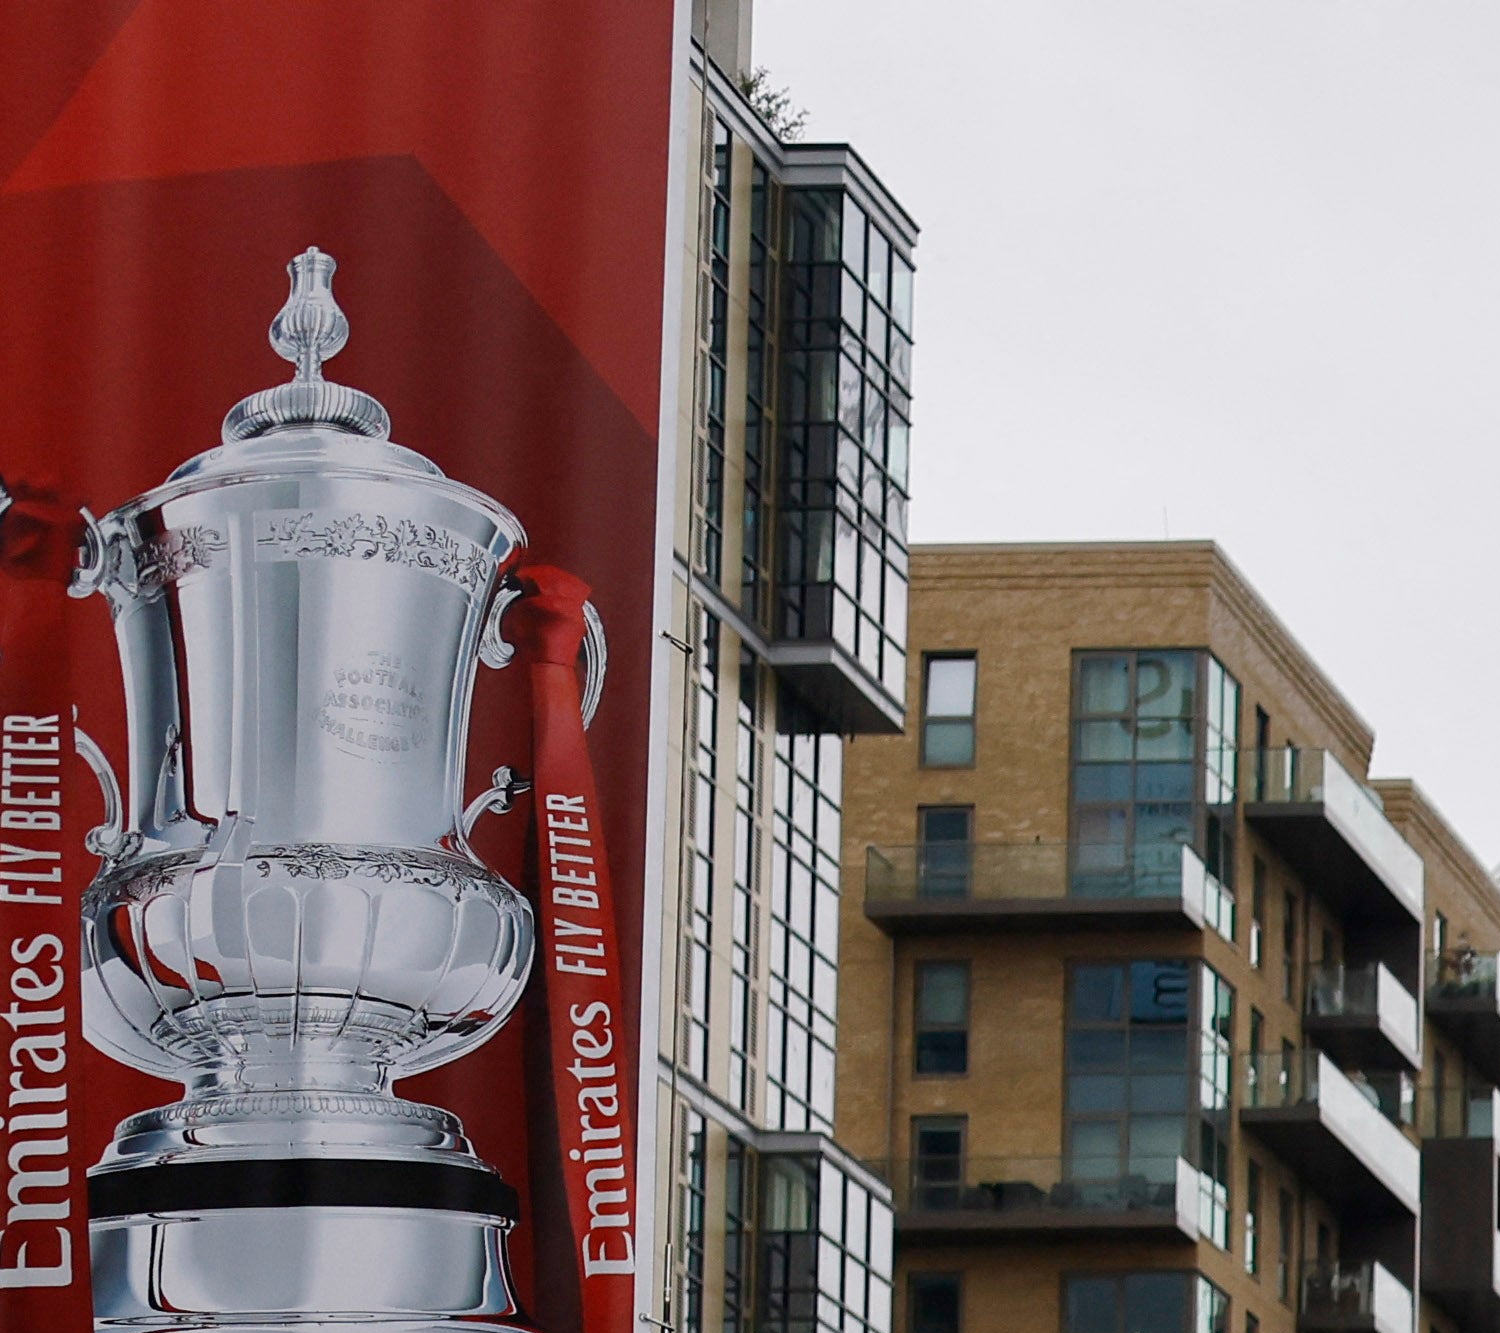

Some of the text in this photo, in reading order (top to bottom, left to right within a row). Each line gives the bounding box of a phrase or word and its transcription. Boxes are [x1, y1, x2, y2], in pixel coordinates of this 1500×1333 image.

[0, 712, 73, 1289] Emirates FLY BETTER
[545, 794, 636, 1278] Emirates FLY BETTER
